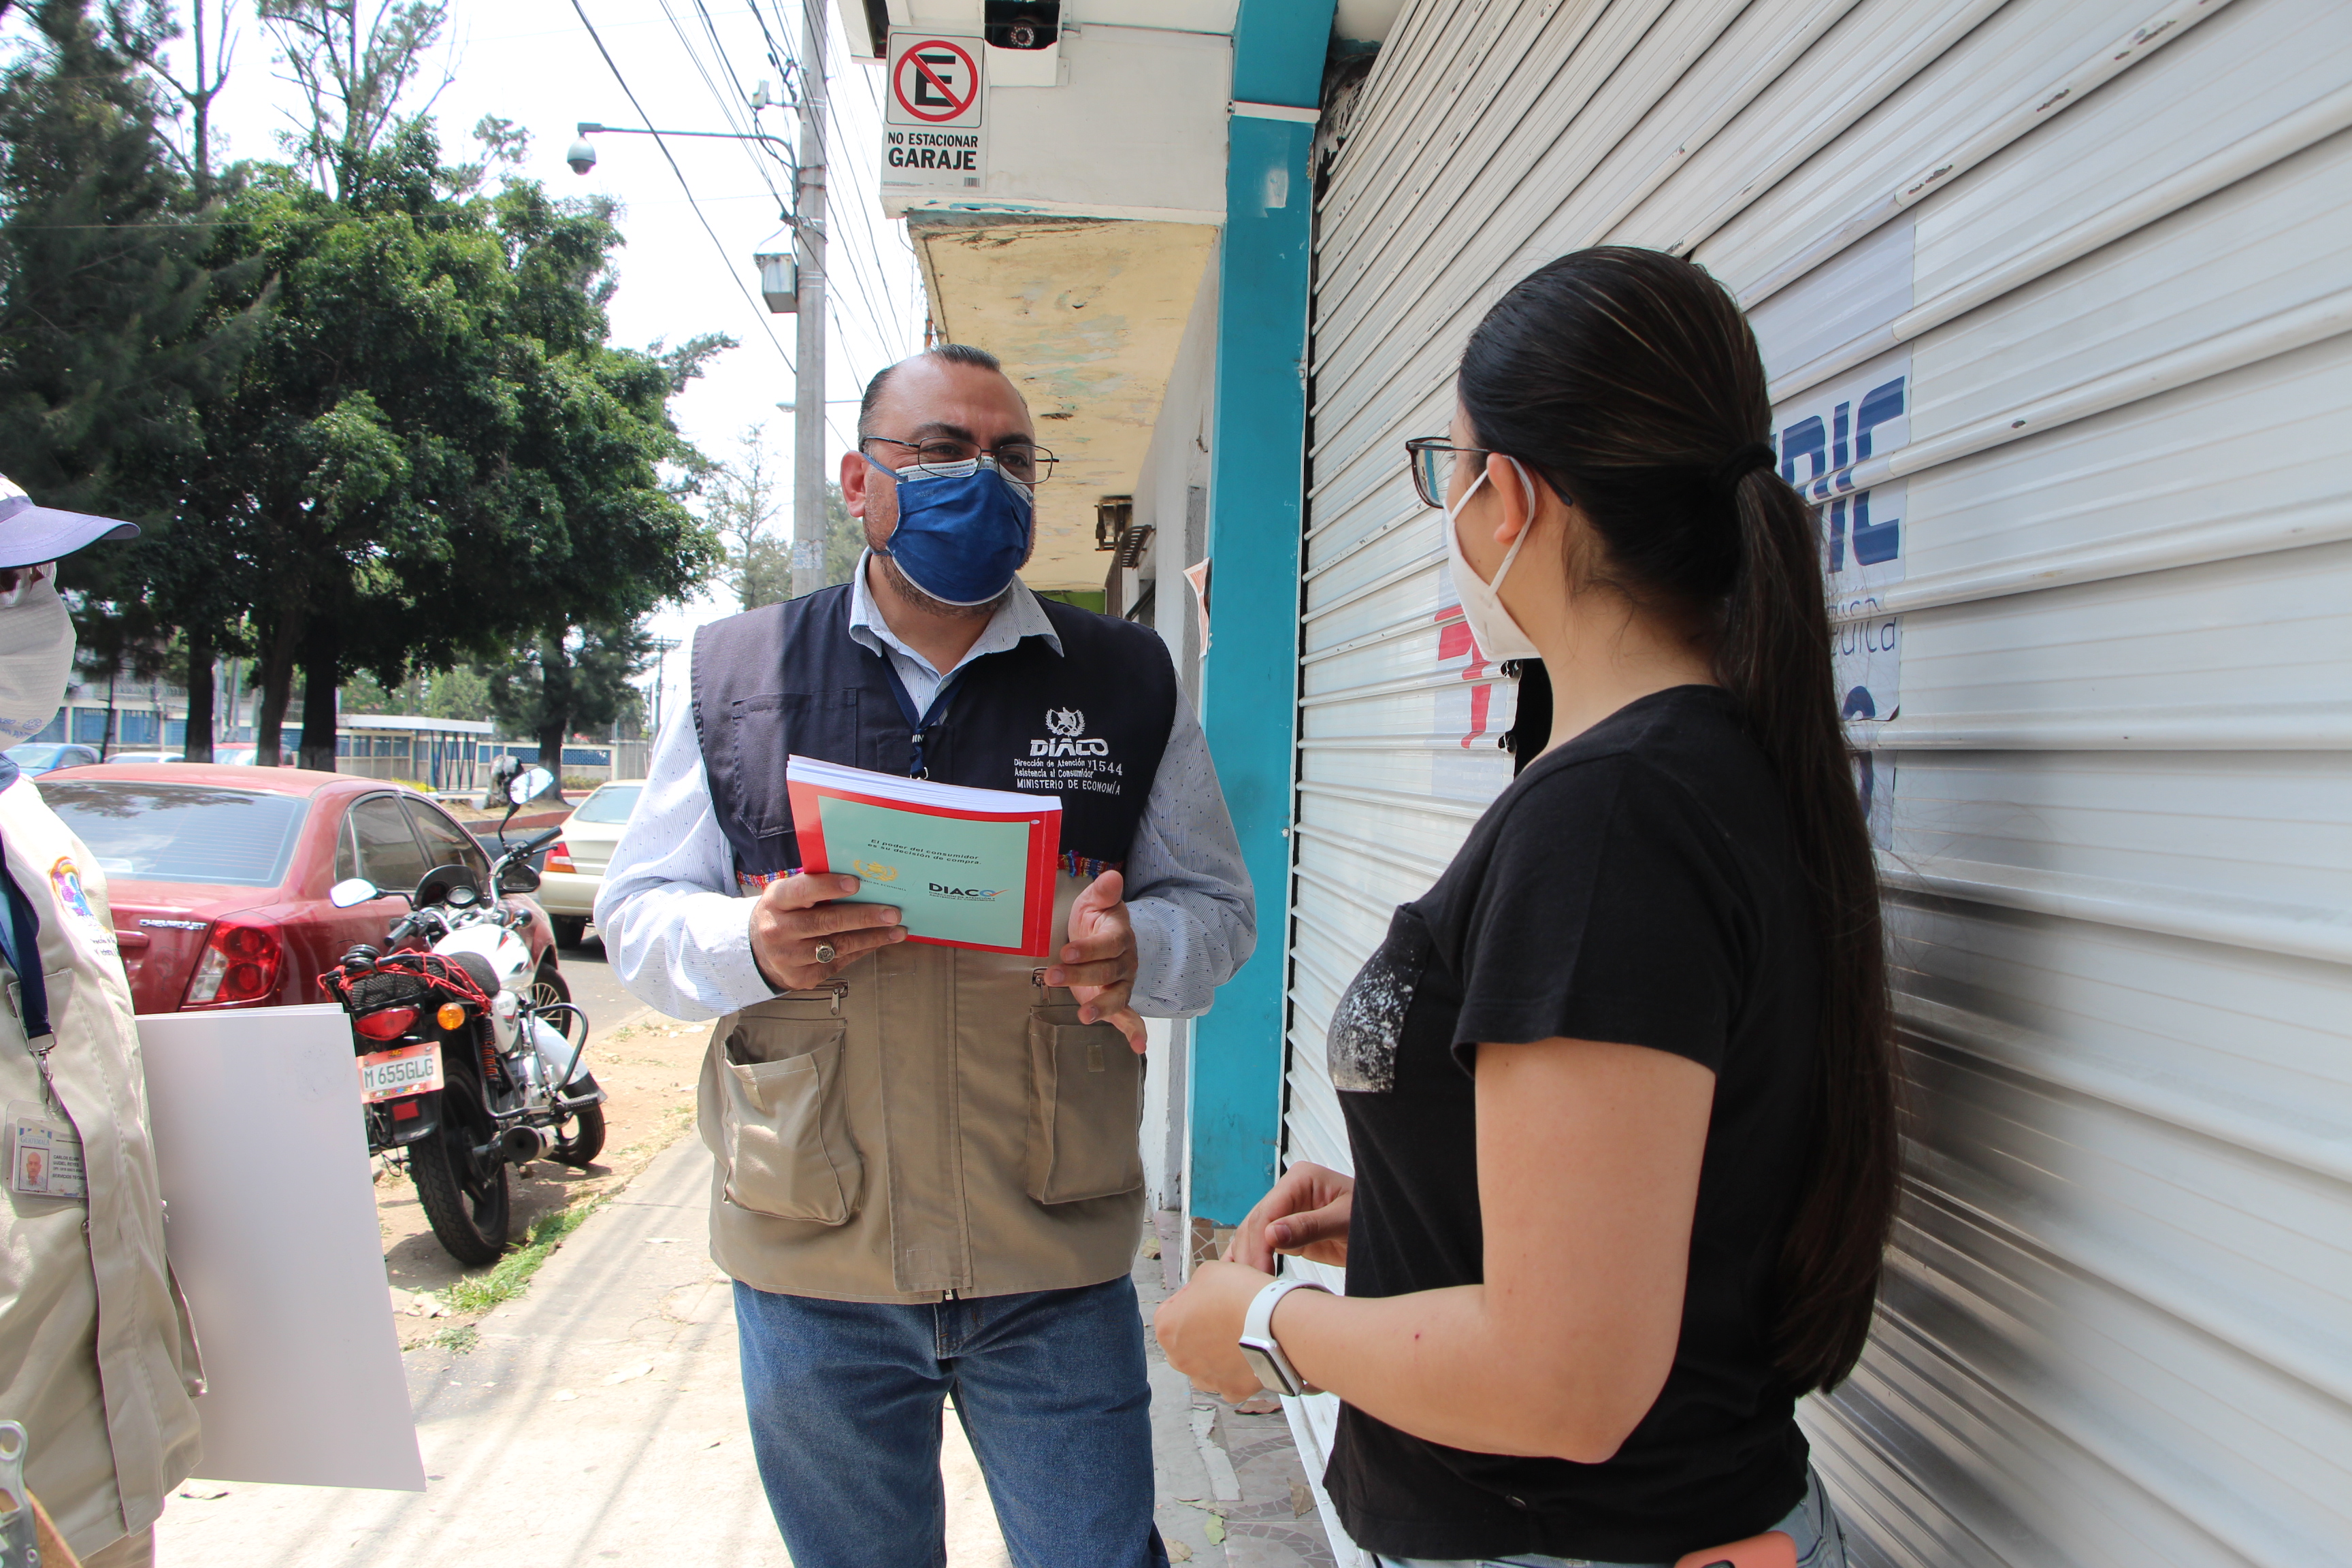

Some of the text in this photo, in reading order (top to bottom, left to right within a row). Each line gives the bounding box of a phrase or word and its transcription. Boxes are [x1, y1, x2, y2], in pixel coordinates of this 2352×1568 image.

[887, 131, 979, 148] NO ESTACIONAR
[888, 147, 977, 171] GARAJE
[1029, 737, 1109, 757] DIACO
[1014, 757, 1092, 768] Dirección de Atención y
[1092, 760, 1123, 776] 1544
[1014, 767, 1094, 779] Asistencia al Consumidor
[1017, 778, 1120, 796] MINISTERIO DE ECONOMÍA
[881, 842, 908, 851] poder
[926, 850, 979, 860] consumidor
[893, 848, 931, 859] decisión
[363, 1058, 434, 1089] M 655GLG
